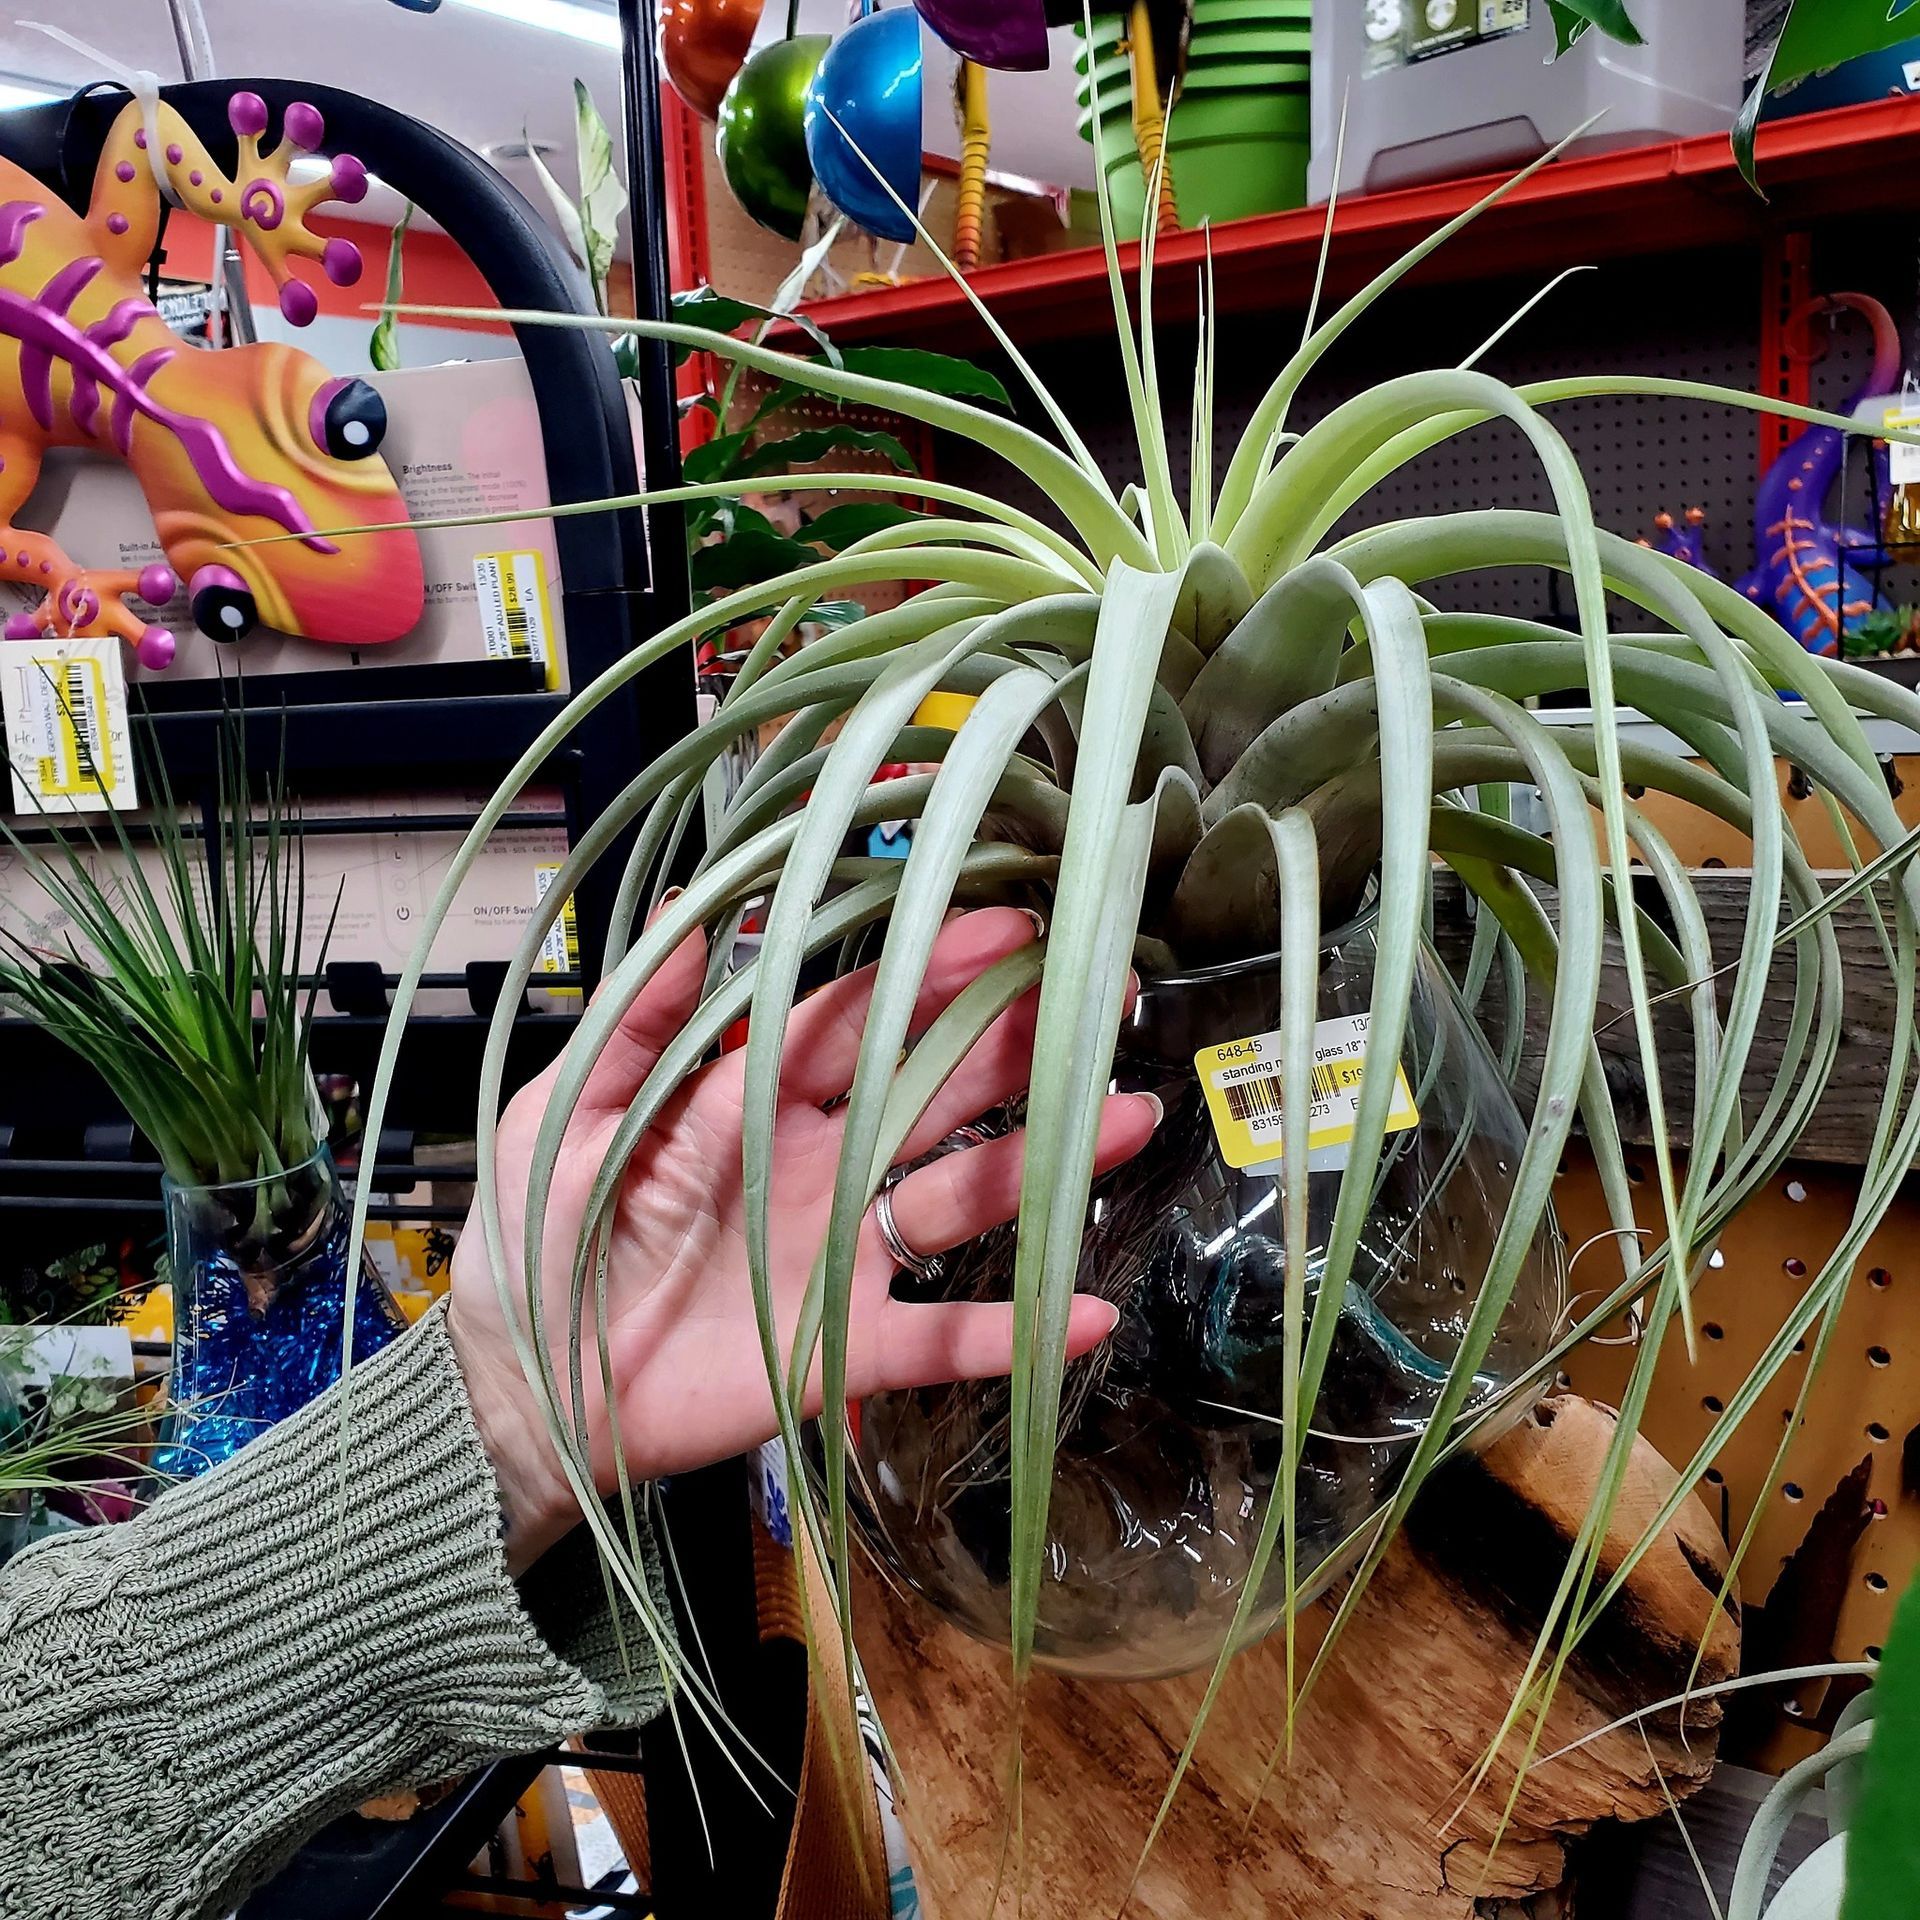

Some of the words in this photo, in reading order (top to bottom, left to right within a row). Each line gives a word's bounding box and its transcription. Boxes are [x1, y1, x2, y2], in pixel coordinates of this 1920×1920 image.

[402, 463, 453, 476] Brightness
[45, 722, 56, 753] GECKO
[473, 905, 511, 917] ON/OFF
[513, 905, 537, 915] Swit
[1216, 1040, 1263, 1061] 648-45
[1222, 1061, 1274, 1081] standing
[1314, 1046, 1344, 1062] glass
[1345, 1040, 1362, 1053] 18"
[1341, 1068, 1363, 1085] $19
